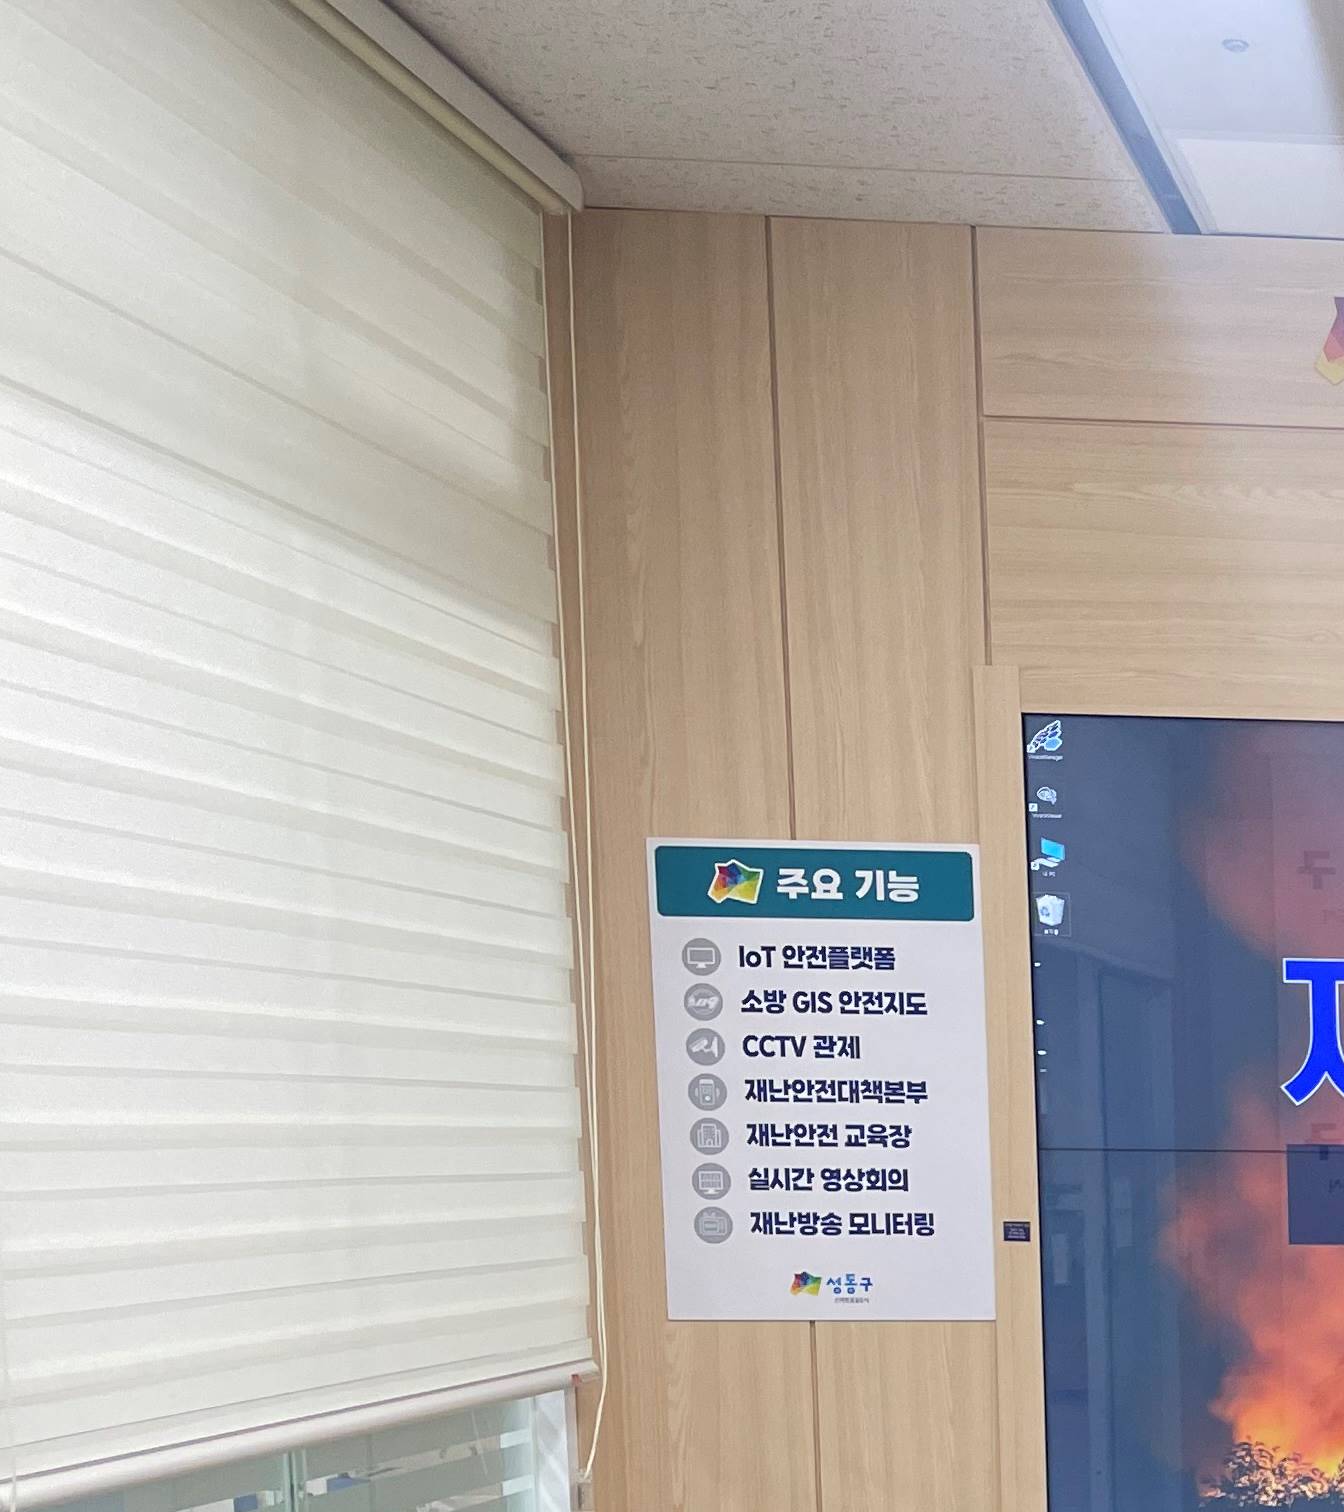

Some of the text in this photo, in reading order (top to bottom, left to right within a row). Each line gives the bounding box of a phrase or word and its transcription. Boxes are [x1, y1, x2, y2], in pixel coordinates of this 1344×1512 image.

[777, 867, 920, 903] 주요 기능
[738, 945, 896, 972] IoT 안전플랫폼
[741, 989, 928, 1017] 소방 GIS 안전지도
[742, 1035, 861, 1060] CCTV 관제
[744, 1079, 929, 1105] 재난안전대책본부
[746, 1122, 913, 1150] 재난안전 교육장
[748, 1167, 909, 1193] 실시간 영상회의
[750, 1211, 936, 1238] 재난방송 모니터링
[826, 1273, 873, 1294] 성동구
